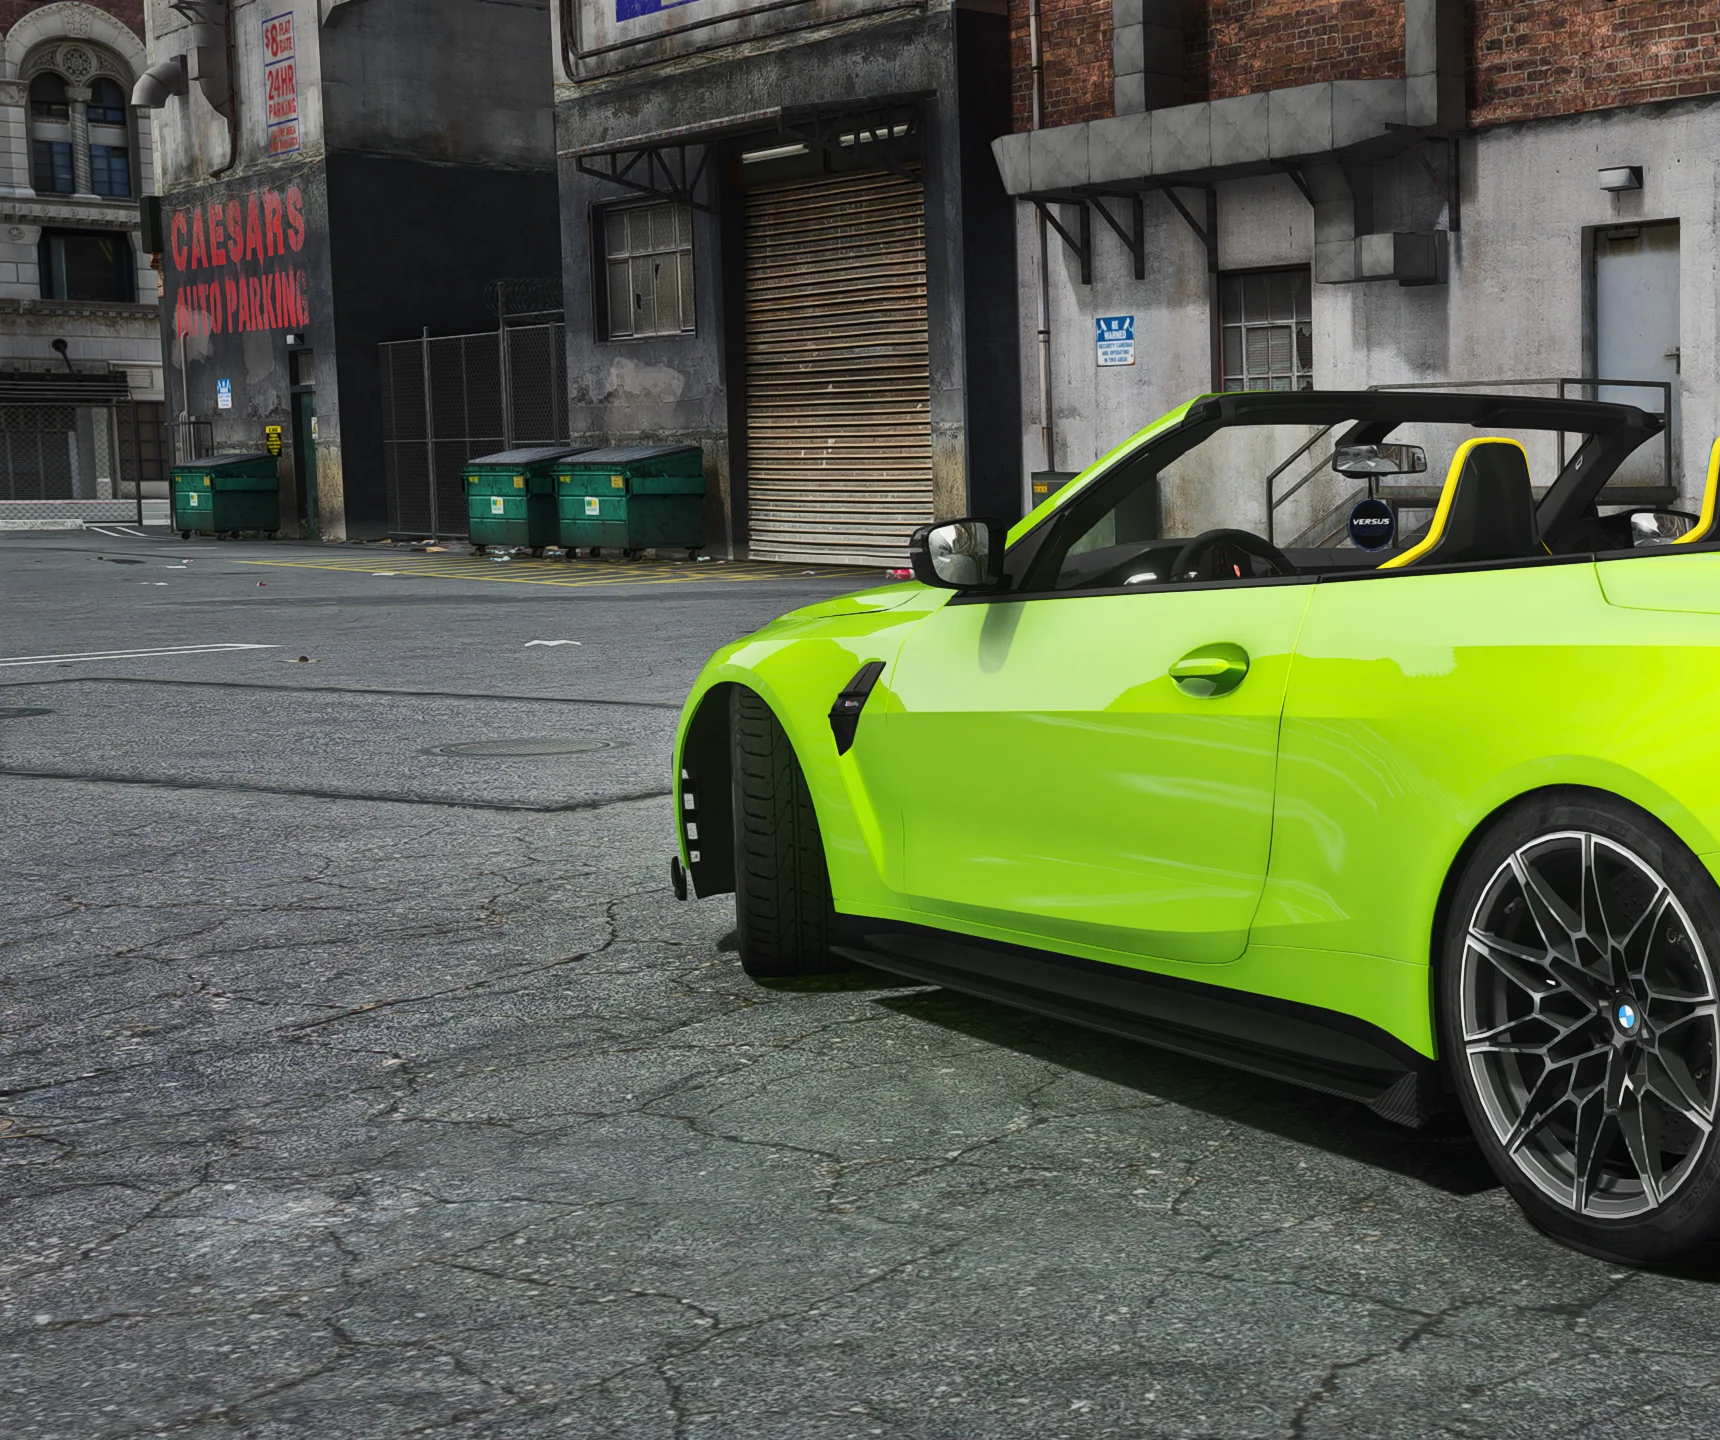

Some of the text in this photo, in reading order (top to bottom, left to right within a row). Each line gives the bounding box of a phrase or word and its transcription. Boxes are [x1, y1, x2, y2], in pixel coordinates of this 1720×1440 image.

[265, 19, 291, 57] $8 FLAT
[280, 36, 293, 53] RATE
[267, 64, 294, 100] 24HR
[269, 97, 296, 120] PARKING
[171, 184, 305, 272] CAESARS
[176, 267, 310, 340] AUTO PARKING
